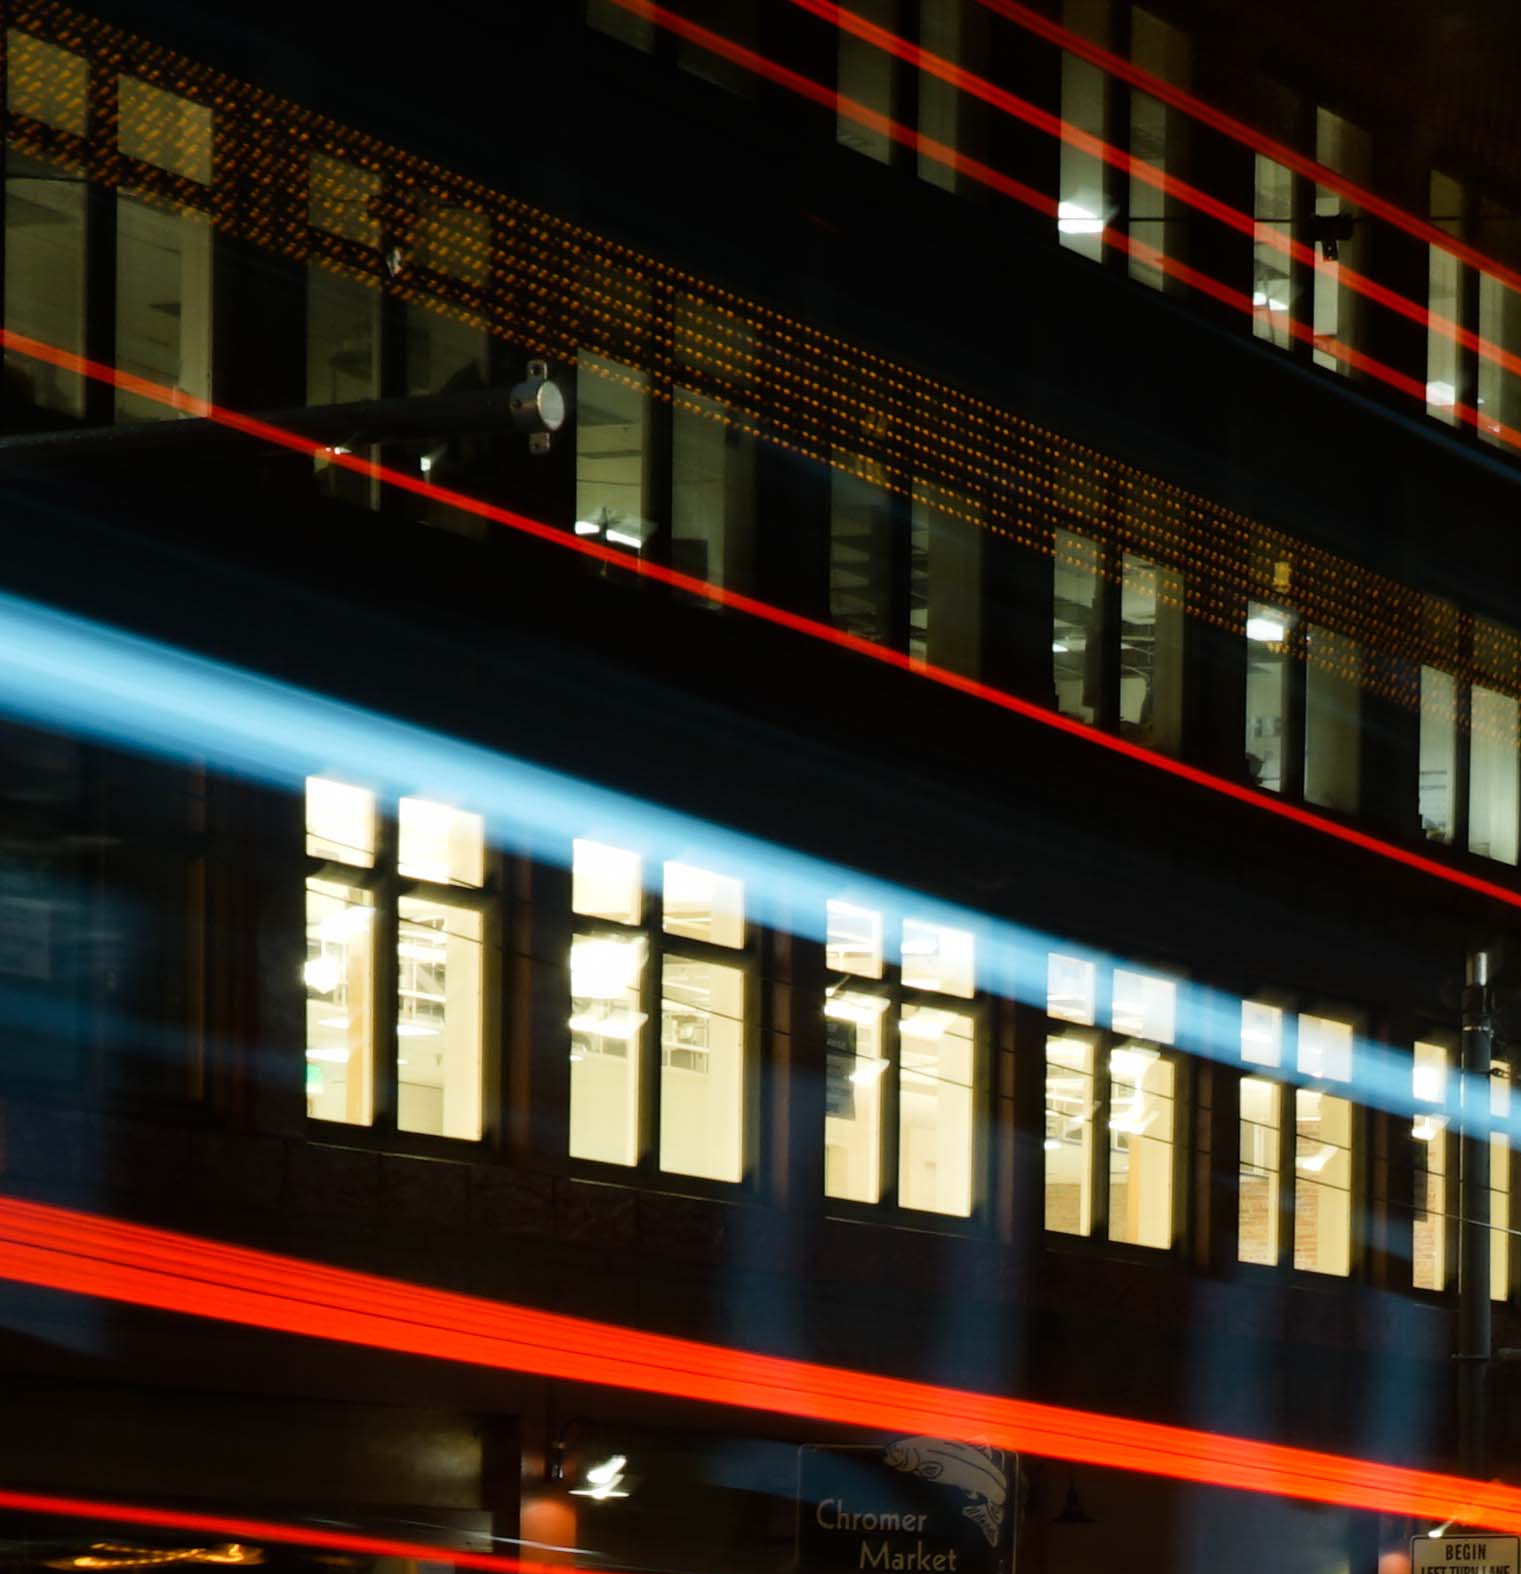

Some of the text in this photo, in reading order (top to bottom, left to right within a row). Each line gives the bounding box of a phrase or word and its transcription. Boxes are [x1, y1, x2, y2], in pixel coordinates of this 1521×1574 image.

[816, 1498, 928, 1532] Chromer
[859, 1540, 957, 1572] Market
[1445, 1544, 1486, 1561] BEGIN
